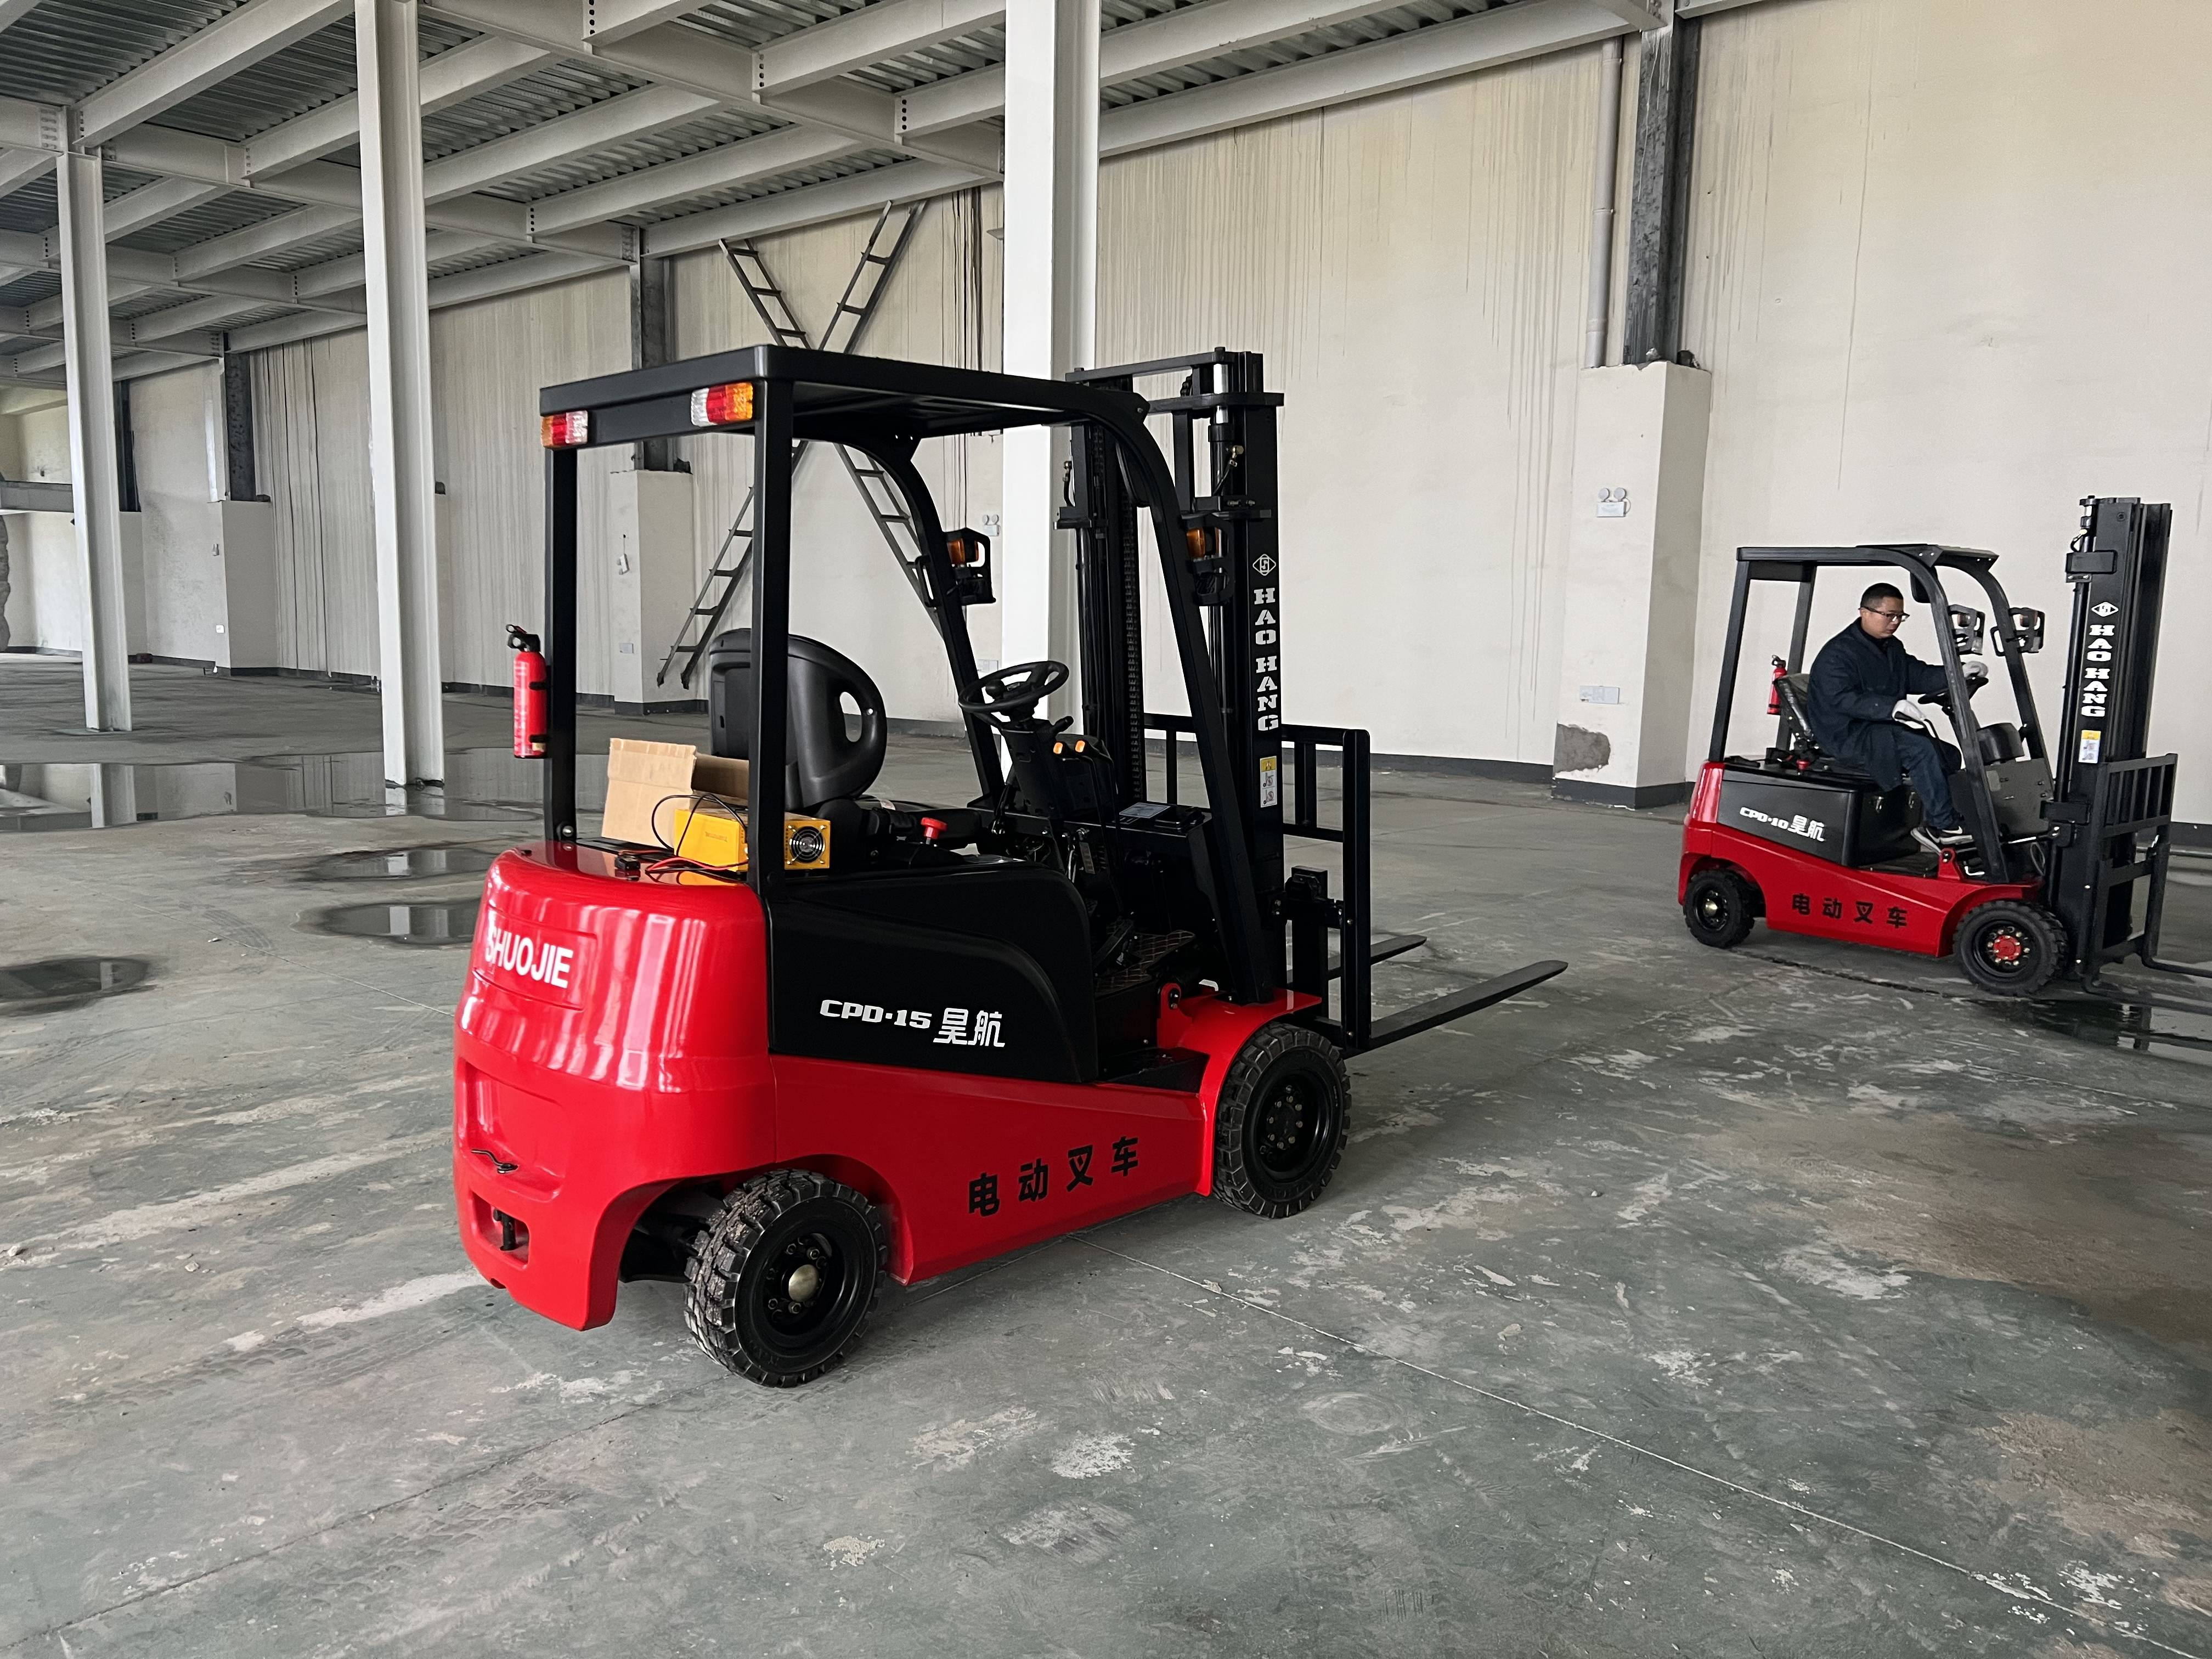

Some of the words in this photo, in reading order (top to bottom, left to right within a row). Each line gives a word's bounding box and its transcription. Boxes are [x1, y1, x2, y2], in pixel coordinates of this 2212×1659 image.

[1254, 587, 1277, 645] HAO
[2086, 624, 2115, 663] HAO
[1256, 655, 1279, 731] HANG
[2080, 667, 2111, 718] HANG
[1792, 893, 1908, 929] 电动叉车
[484, 926, 574, 989] SHUOJIE
[933, 1007, 1006, 1048] 昊航
[968, 1136, 1139, 1217] 电动叉车
